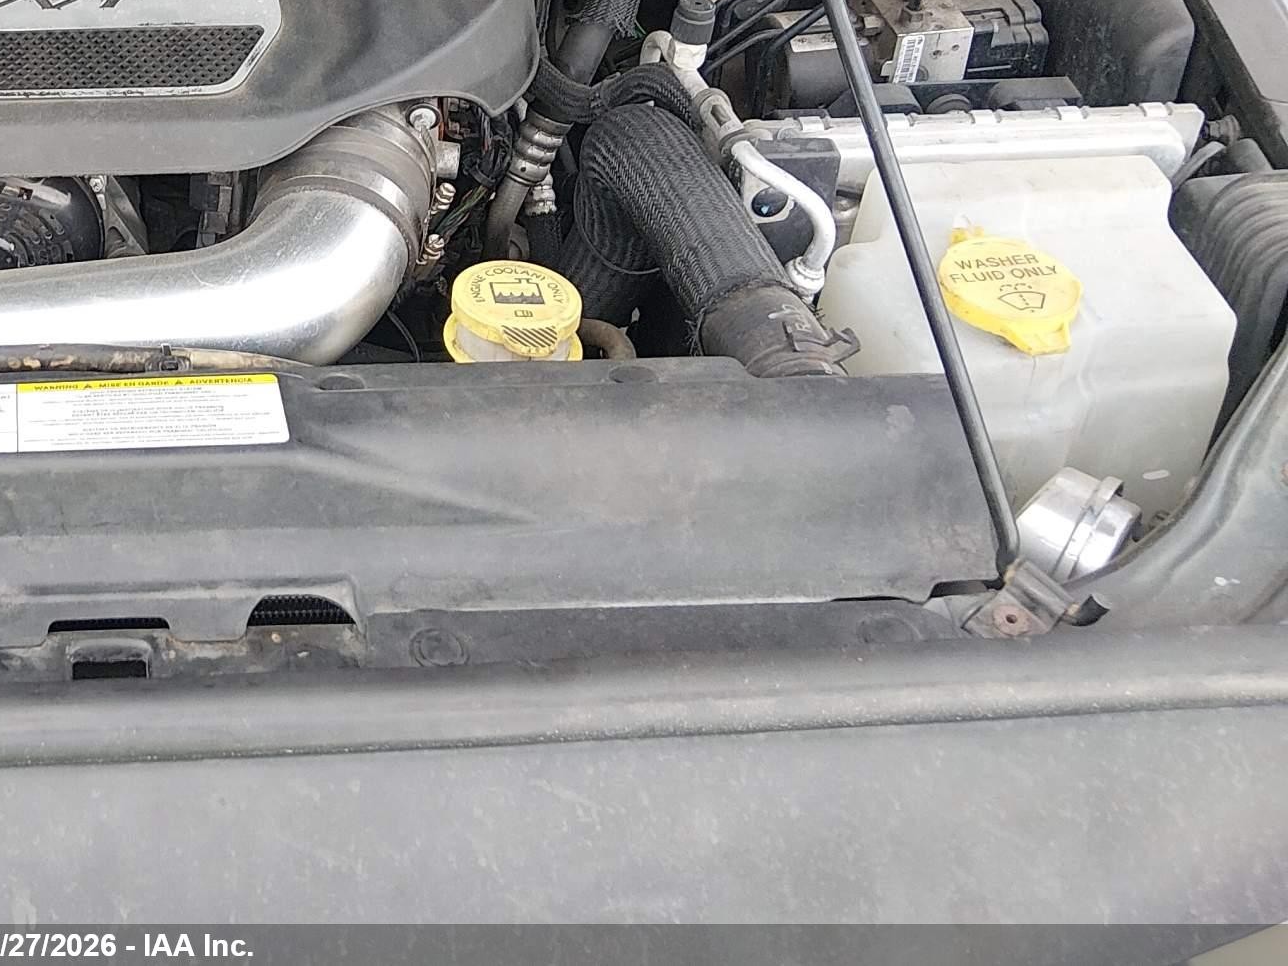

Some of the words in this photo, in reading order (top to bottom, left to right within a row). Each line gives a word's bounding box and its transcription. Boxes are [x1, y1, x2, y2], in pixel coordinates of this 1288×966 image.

[954, 253, 1040, 270] WASHER
[949, 270, 1005, 283] FLUID
[1010, 265, 1058, 280] ONLY
[470, 274, 486, 303] ENGINE
[485, 267, 546, 281] COOLANT
[547, 282, 565, 303] ONLY
[190, 377, 253, 385] ADVERTENCIA
